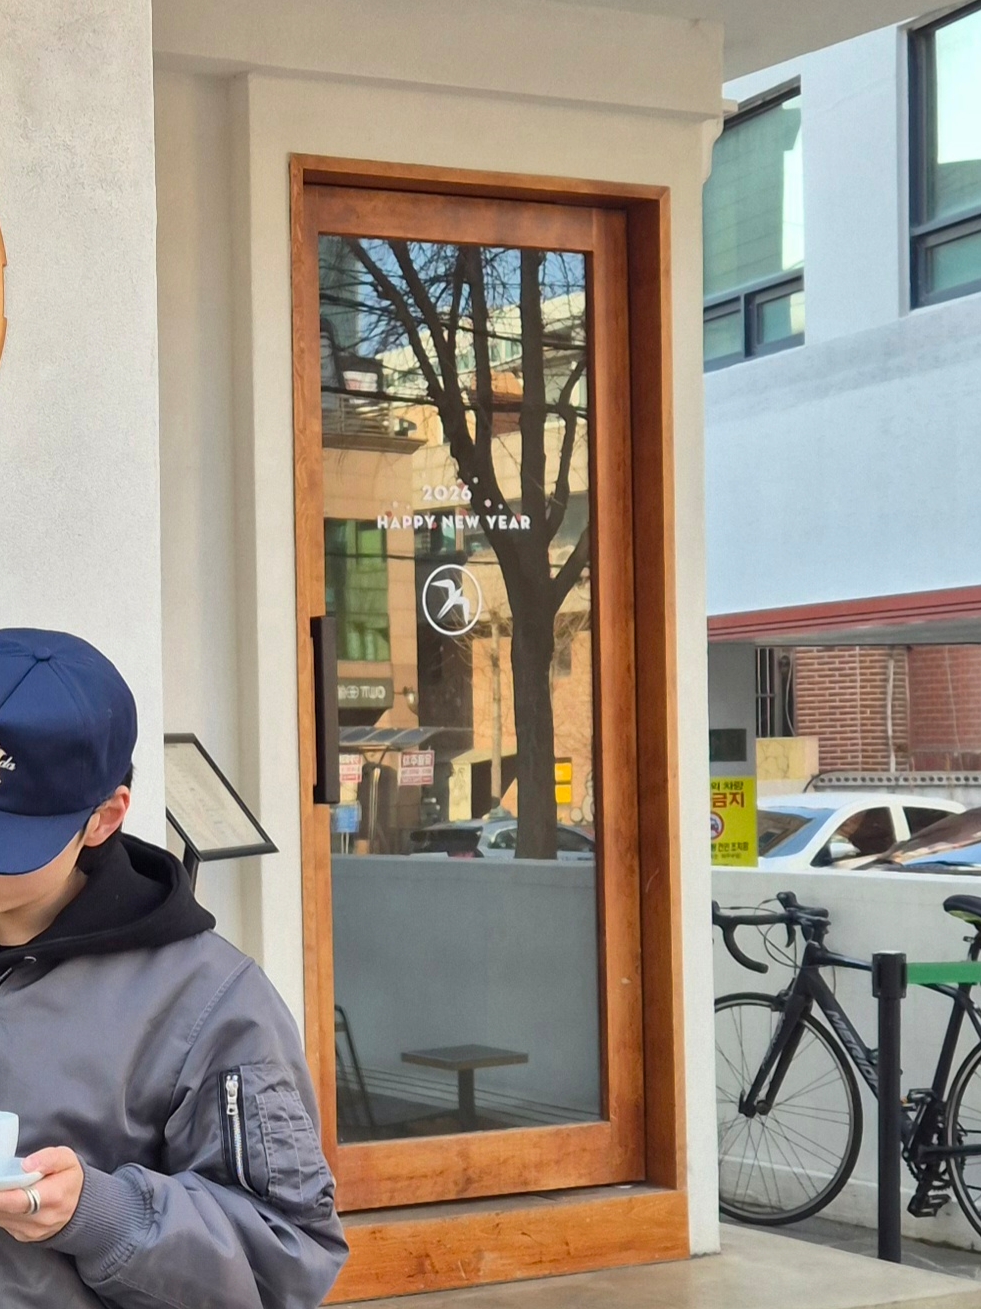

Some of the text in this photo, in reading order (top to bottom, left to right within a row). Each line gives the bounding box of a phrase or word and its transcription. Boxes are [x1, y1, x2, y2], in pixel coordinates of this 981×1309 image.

[422, 484, 473, 501] 2026
[376, 514, 531, 530] HAPPY NEW YEAR
[712, 791, 745, 809] 금지
